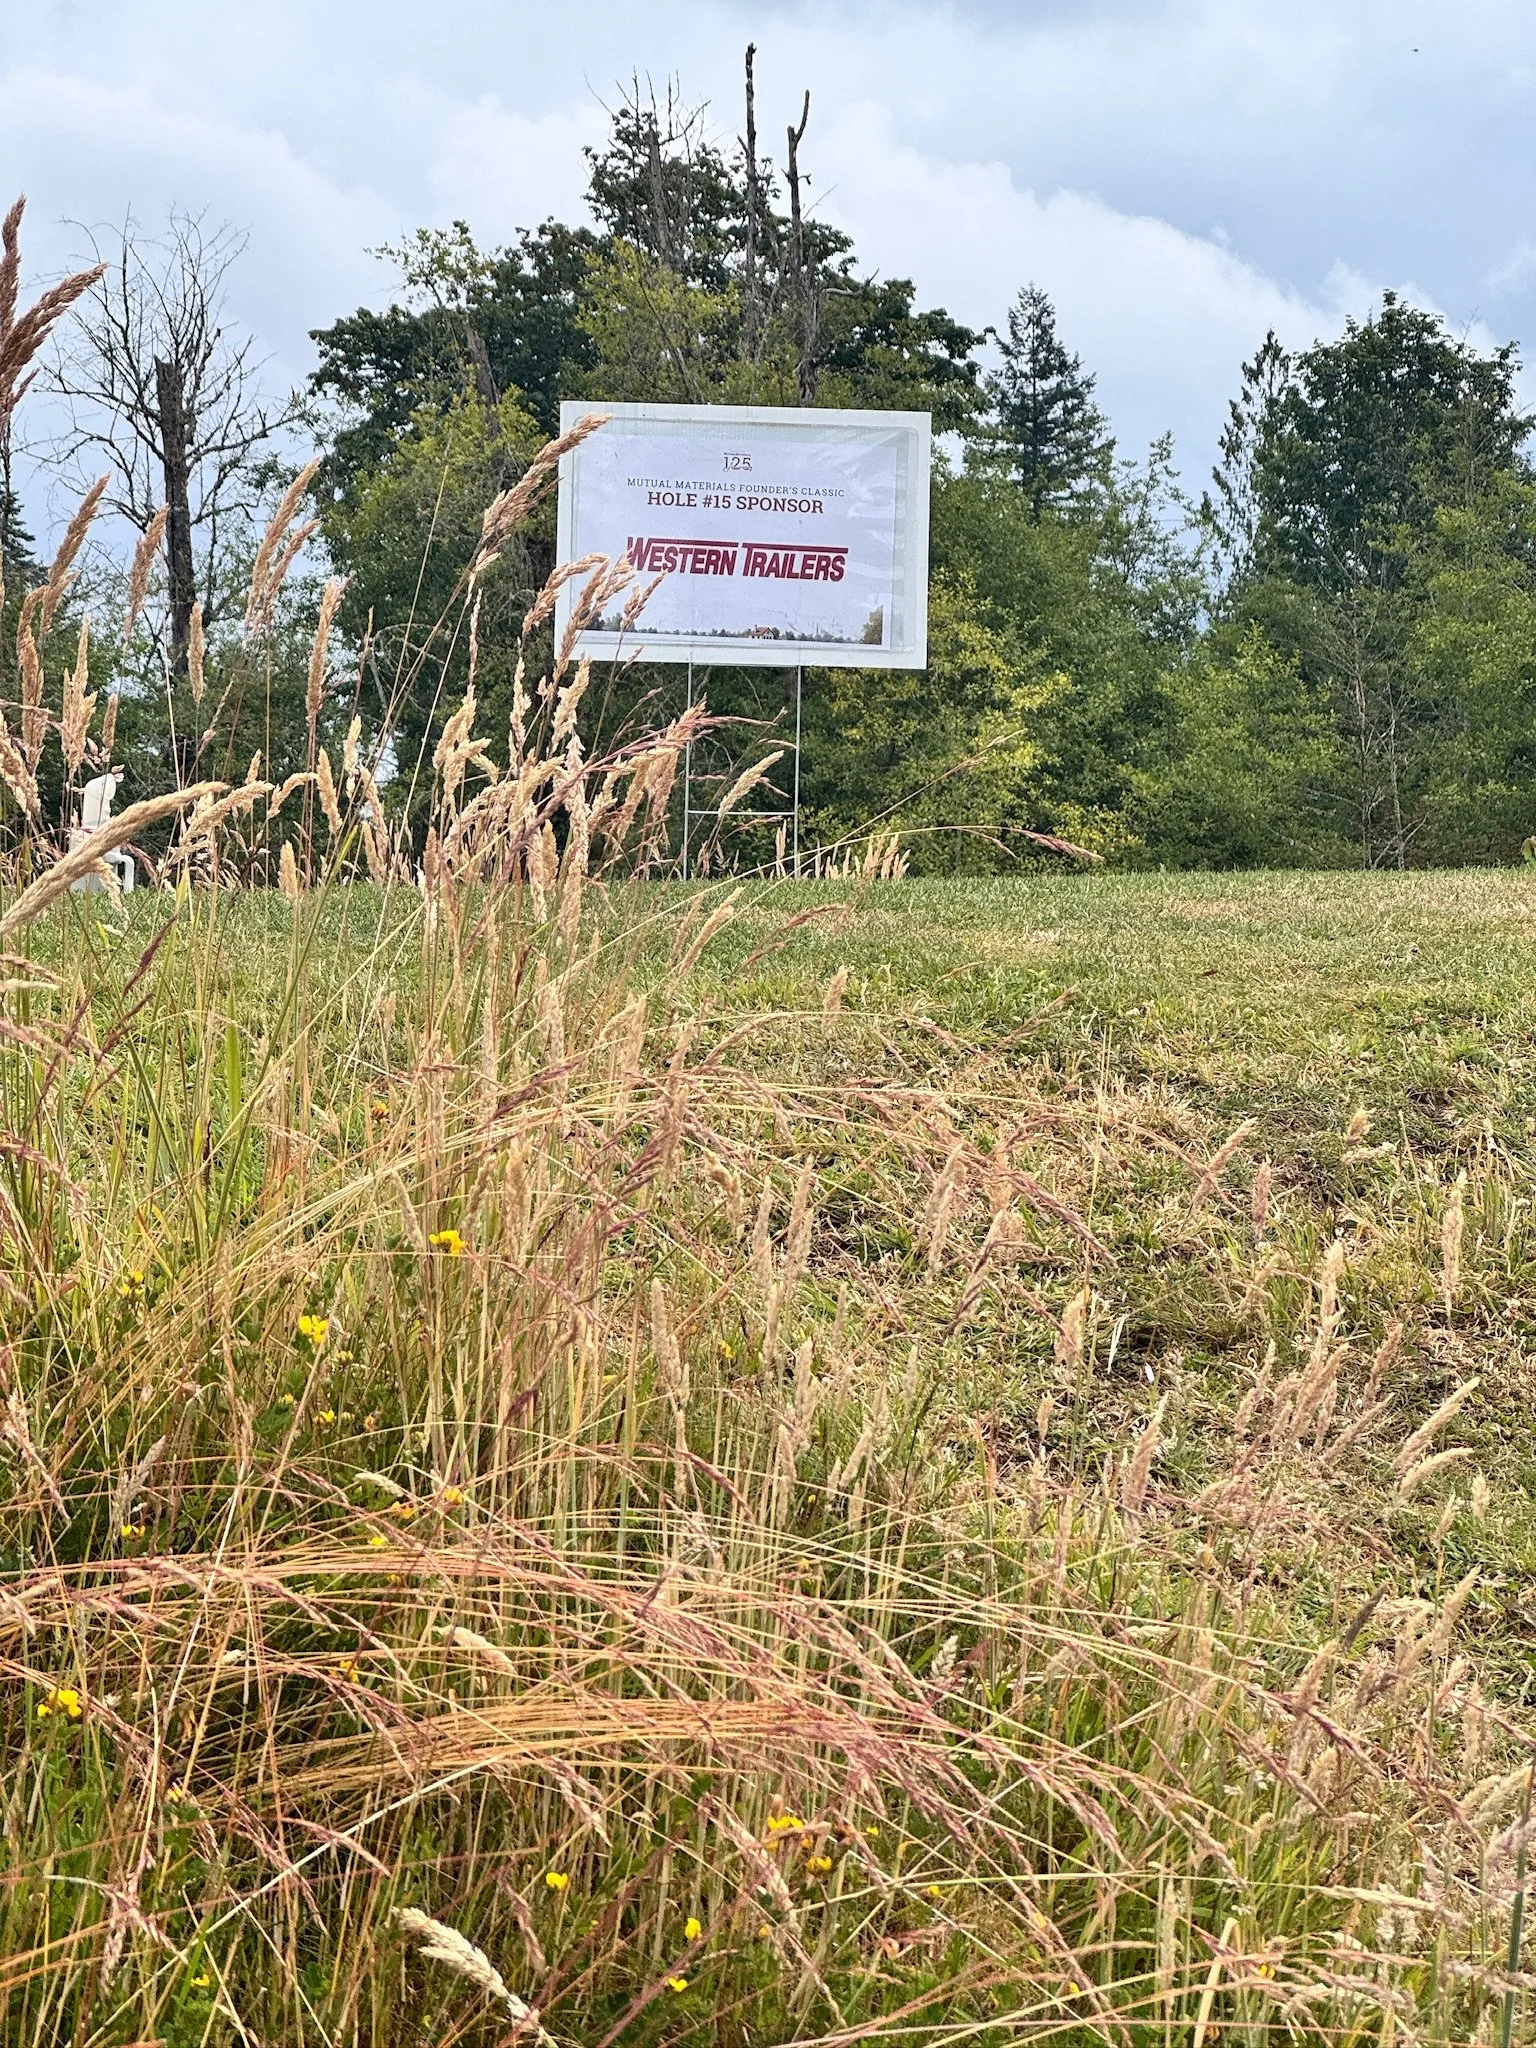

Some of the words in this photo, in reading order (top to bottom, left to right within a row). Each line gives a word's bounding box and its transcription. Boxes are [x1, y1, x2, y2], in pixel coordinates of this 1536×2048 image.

[723, 456, 751, 471] 125
[627, 478, 672, 489] MUTUAL
[675, 480, 736, 492] MATERIALS
[739, 484, 798, 495] FOUNDER'S
[801, 487, 845, 498] CLASSIC
[647, 491, 698, 508] HOLE
[702, 494, 732, 509] #15
[736, 496, 824, 514] SPONSOR
[627, 536, 739, 576] WESTERN
[742, 542, 849, 582] TRAILERS
